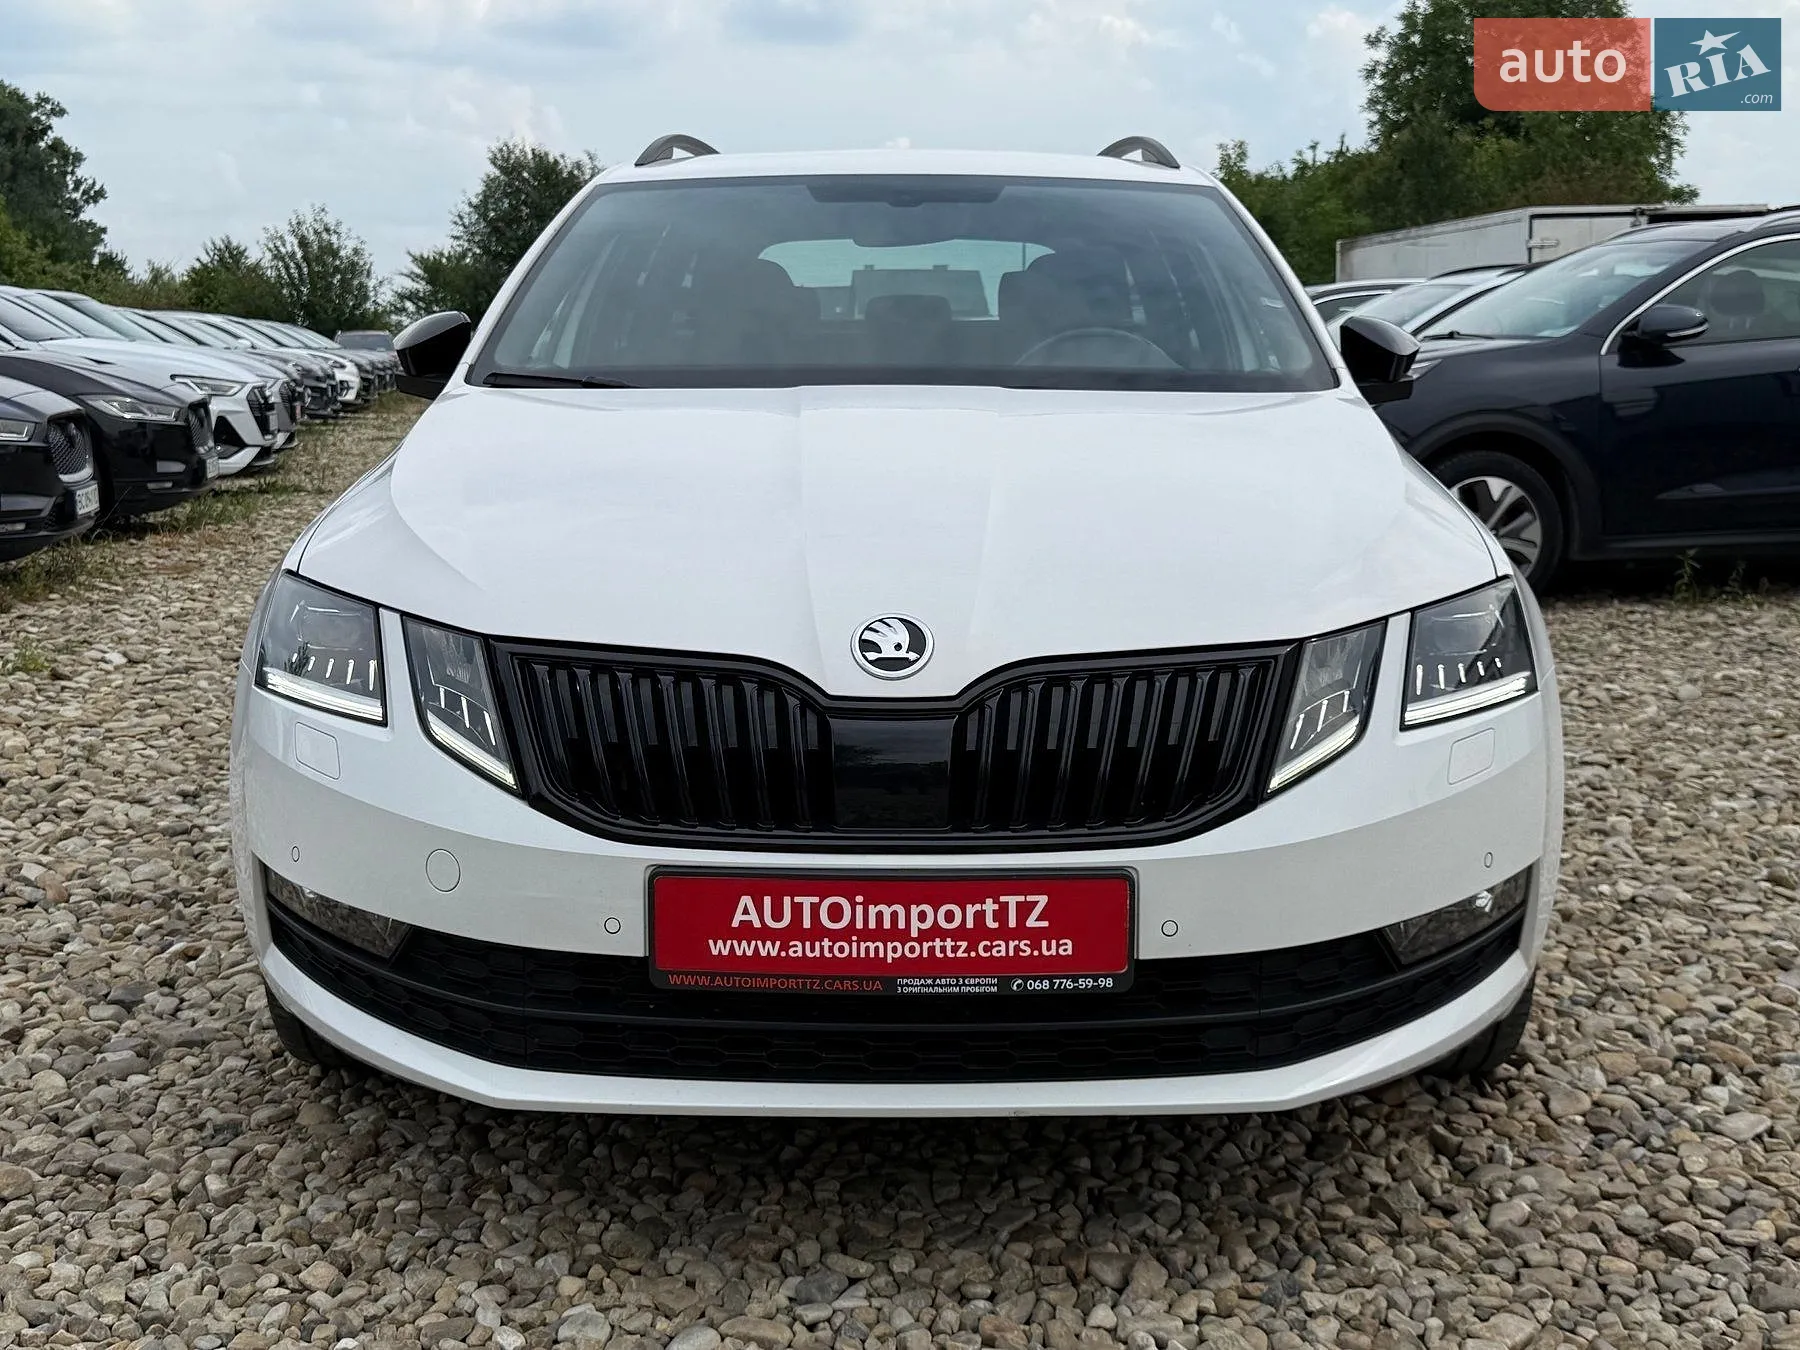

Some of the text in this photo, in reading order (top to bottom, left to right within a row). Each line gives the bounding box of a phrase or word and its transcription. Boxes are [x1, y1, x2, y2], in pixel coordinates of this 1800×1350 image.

[731, 895, 1049, 937] AUTOimportTZ
[708, 936, 1073, 963] www.autoimporttz.cars.ua
[668, 974, 883, 991] WWW.AUTOIMPORTTZ.CARS.UA
[897, 978, 933, 986] ПРОДАЖ
[1027, 978, 1114, 990] 068 776-59-98
